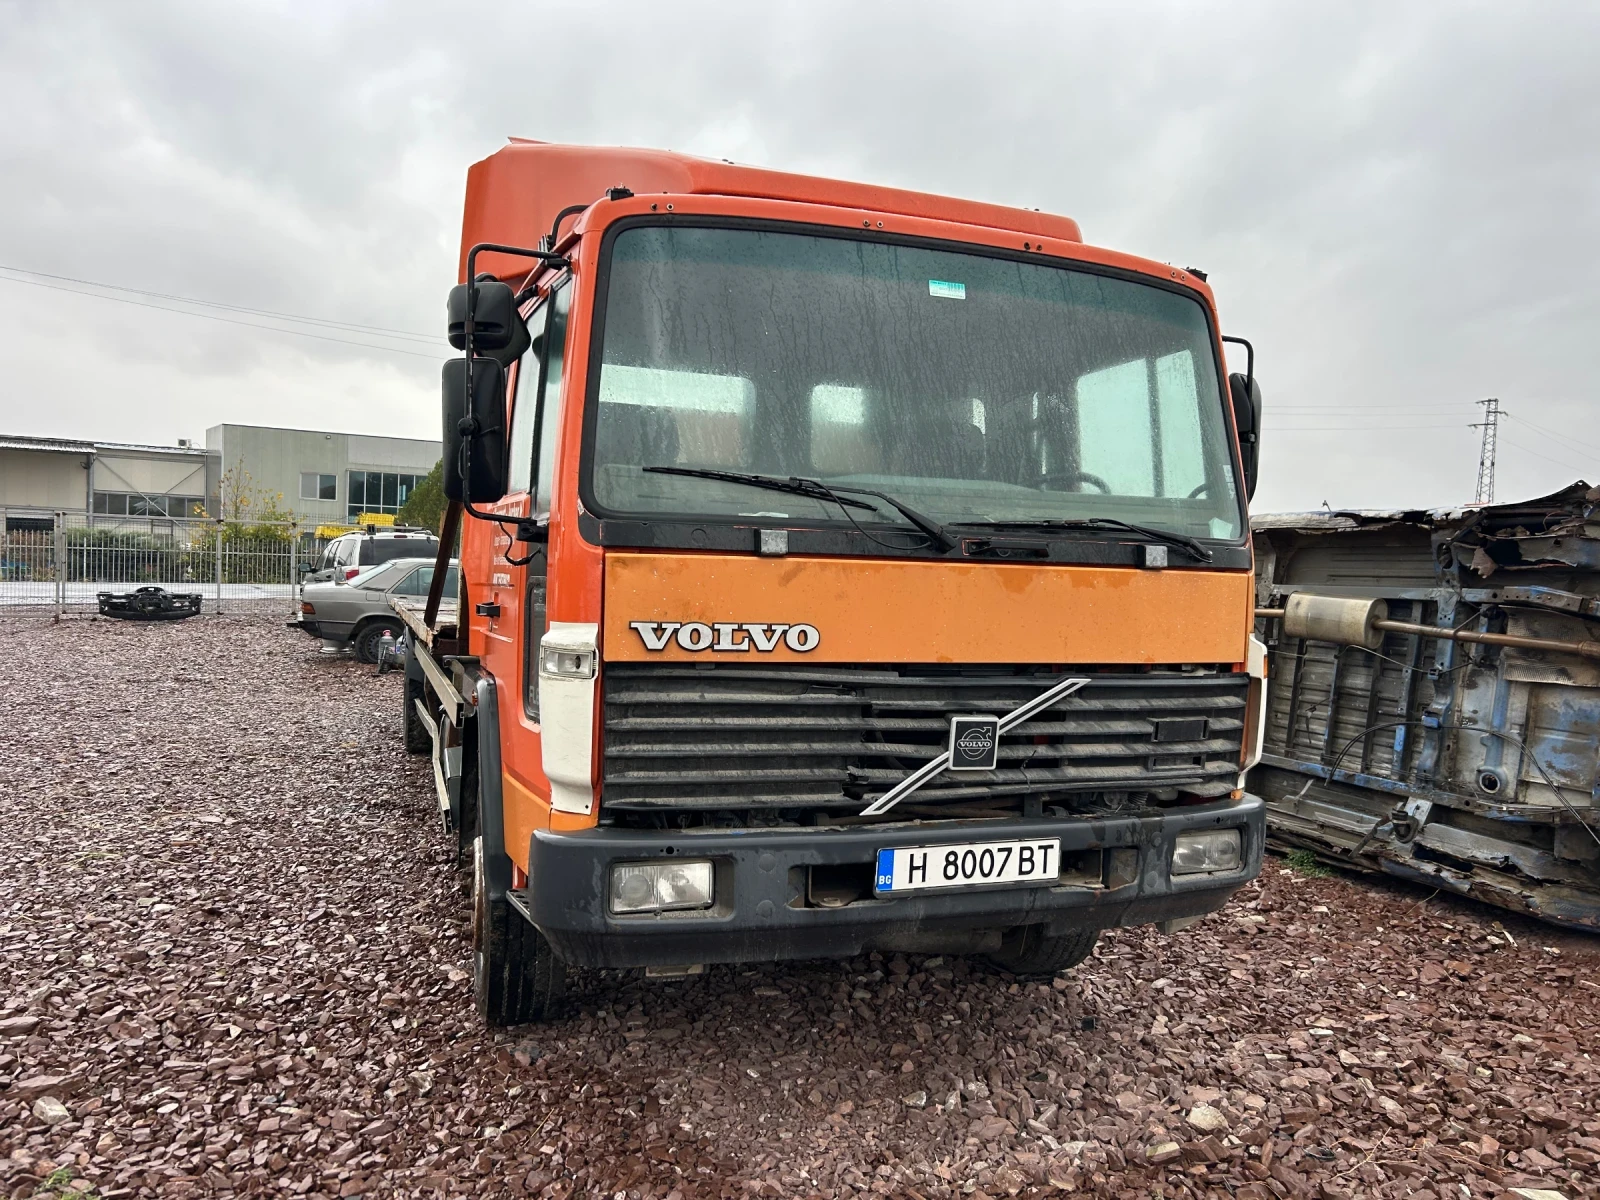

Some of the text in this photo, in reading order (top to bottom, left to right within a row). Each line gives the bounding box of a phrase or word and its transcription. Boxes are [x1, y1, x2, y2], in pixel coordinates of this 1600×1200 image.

[629, 621, 820, 652] VOLVO
[878, 875, 892, 885] BG
[908, 852, 927, 884] H
